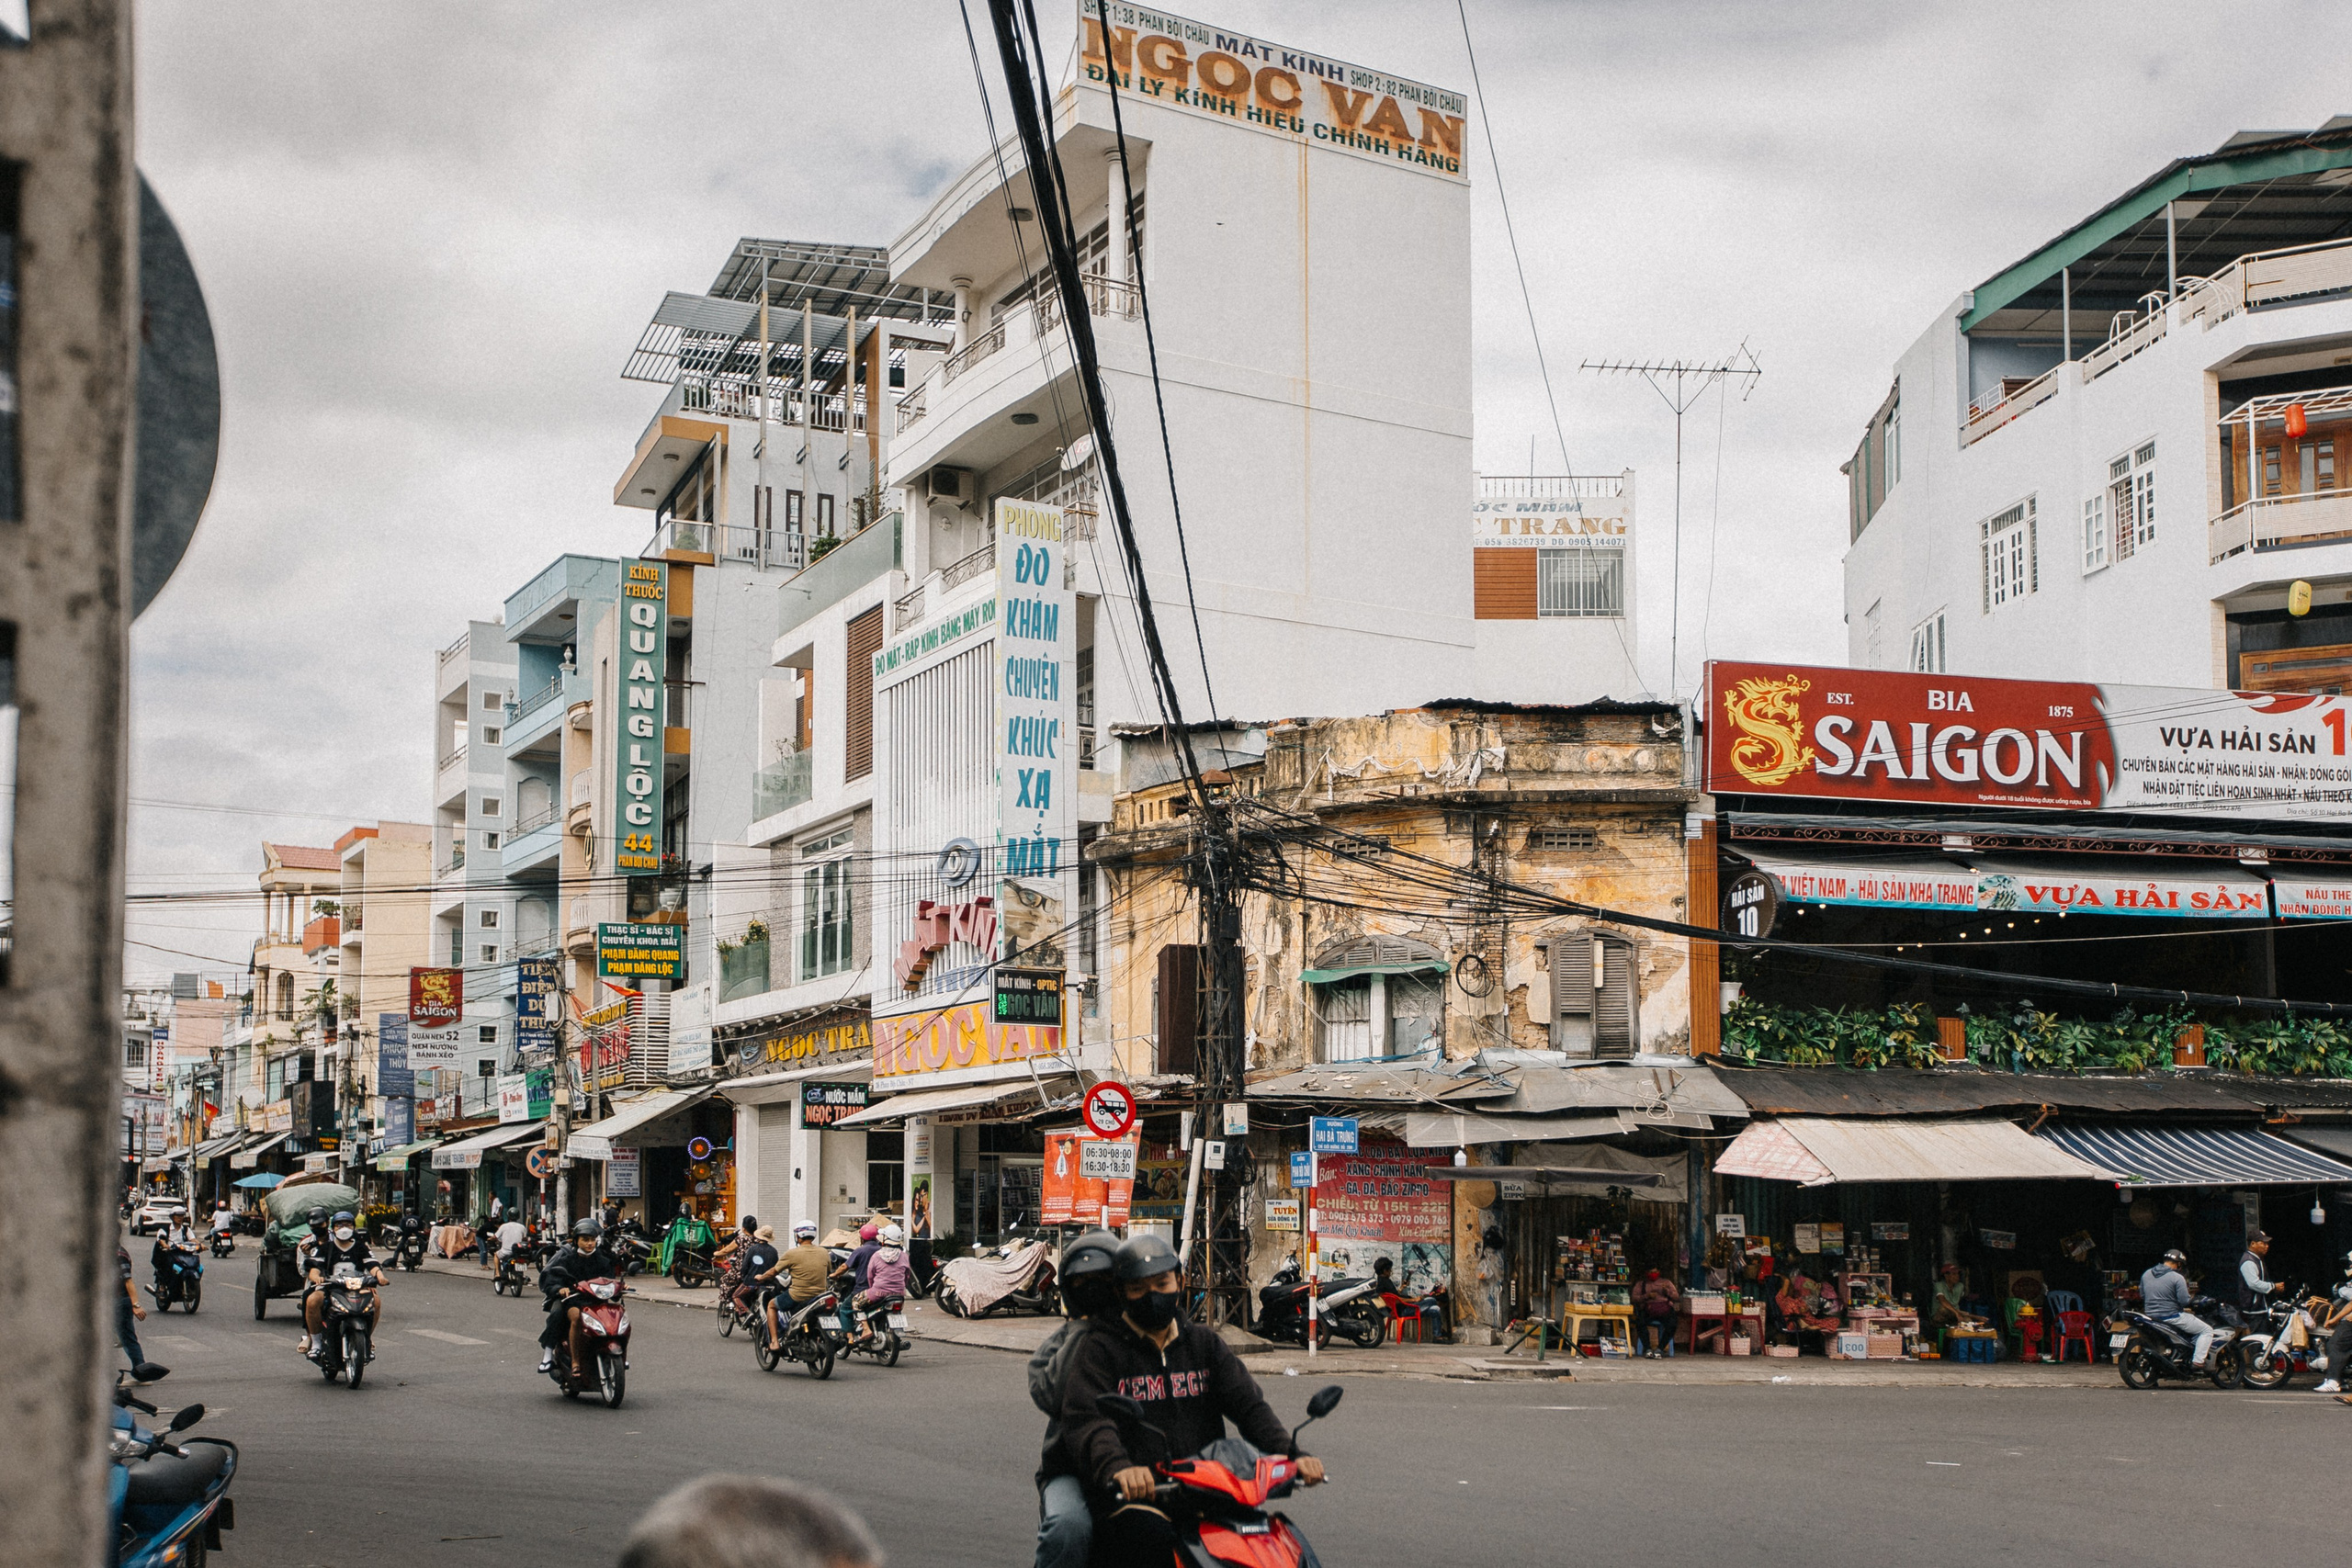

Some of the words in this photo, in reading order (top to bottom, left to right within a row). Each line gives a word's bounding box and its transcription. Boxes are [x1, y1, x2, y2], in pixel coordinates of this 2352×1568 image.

[1139, 13, 1163, 33] PHAN
[1216, 34, 1273, 62] MẮT
[1282, 51, 1343, 83] KÍNH
[1351, 70, 1373, 90] SHOP
[1399, 83, 1421, 104] PHAN
[1140, 76, 1164, 96] LÝ
[1175, 86, 1237, 116] KÍNH
[1314, 123, 1389, 155] CHÍNH
[1494, 516, 1628, 535] TRANG
[629, 563, 659, 581] KÍNH
[1015, 542, 1050, 586] ĐO
[624, 581, 663, 600] THUỐC
[1006, 592, 1058, 643] KHÁM
[922, 627, 938, 654] KÍNH
[963, 604, 979, 634] MÁY
[1006, 651, 1060, 702] CHUYÊN
[1826, 692, 1854, 705] EST.
[2048, 705, 2074, 717] 1875
[1928, 689, 1974, 712] BIA
[1007, 709, 1058, 759] KHÚC
[2159, 727, 2214, 754] VỰA
[2221, 725, 2261, 751] HẢI
[2268, 728, 2315, 754] SẢN
[1815, 715, 2084, 788] SAIGON
[2122, 756, 2156, 773] CHUYÊN
[2159, 757, 2176, 773] BÁN
[2178, 758, 2195, 773] CÁC
[2197, 759, 2214, 779] MẶT
[2216, 760, 2240, 776] HÀNG
[2243, 761, 2256, 777] HẢI
[2258, 761, 2275, 778] SẢN
[2310, 764, 2335, 781] ĐÓNG
[2336, 765, 2351, 782] GÓI
[1016, 768, 1051, 818] XẠ
[2143, 778, 2166, 798] NHẬN
[2169, 779, 2185, 799] ĐẶT
[2187, 780, 2205, 800] TIỆC
[2207, 781, 2224, 797] LIÊN
[2227, 785, 2251, 798] HOAN
[2254, 787, 2272, 801] SINH
[2323, 790, 2344, 803] THEO
[624, 832, 652, 852] 44
[1007, 823, 1061, 878] MẮT
[1731, 884, 1746, 908] HẢI
[1747, 879, 1764, 903] SẢN
[1791, 873, 1814, 901] VIỆT
[1819, 878, 1846, 898] NAM
[1859, 873, 1878, 899] HẢI
[1882, 874, 1905, 901] SẢN
[1910, 882, 1932, 903] NHA
[1937, 884, 1973, 905] TRANG
[2024, 884, 2105, 910] VỰA
[2114, 883, 2181, 910] HẢI
[2190, 885, 2266, 911] SẢN
[2305, 886, 2328, 899] NẤU
[2280, 903, 2309, 916] NHẬN
[2312, 903, 2341, 915] ĐÓNG
[646, 925, 663, 935] BÁC
[1737, 906, 1758, 937] 10
[602, 936, 635, 945] CHUYÊN
[602, 949, 626, 961] PHẠM
[651, 950, 679, 961] QUANG
[607, 963, 633, 975] PHẠM
[998, 974, 1013, 988] MẮT
[1014, 976, 1031, 989] KÍNH
[1036, 979, 1057, 991] OPTIC
[413, 1006, 458, 1016] SAIGON
[1033, 991, 1057, 1018] VÂN
[446, 1031, 459, 1041] 52
[765, 1031, 820, 1064] NGỌC
[806, 1105, 832, 1126] NGỌC
[1316, 1130, 1326, 1142] HAI
[1327, 1128, 1335, 1142] BÀ
[1086, 1148, 1132, 1158] 06:30-08:00
[1085, 1161, 1130, 1172] 16:30-18:30
[1373, 1162, 1401, 1178] CHÍNH
[1346, 1182, 1361, 1197] GA,
[1401, 1183, 1430, 1197] ZIPPO
[1504, 1183, 1522, 1191] SỬA
[1273, 1205, 1297, 1214] TUYÊN
[1363, 1197, 1380, 1211] TỪ
[1384, 1201, 1409, 1212] 15H
[1421, 1201, 1448, 1213] 22H
[1329, 1211, 1349, 1221] 0903
[1368, 1213, 1384, 1224] 373
[1391, 1214, 1411, 1224] 0979
[1414, 1214, 1430, 1224] 096
[1432, 1215, 1447, 1224] 762
[1398, 1225, 1412, 1237] Xin
